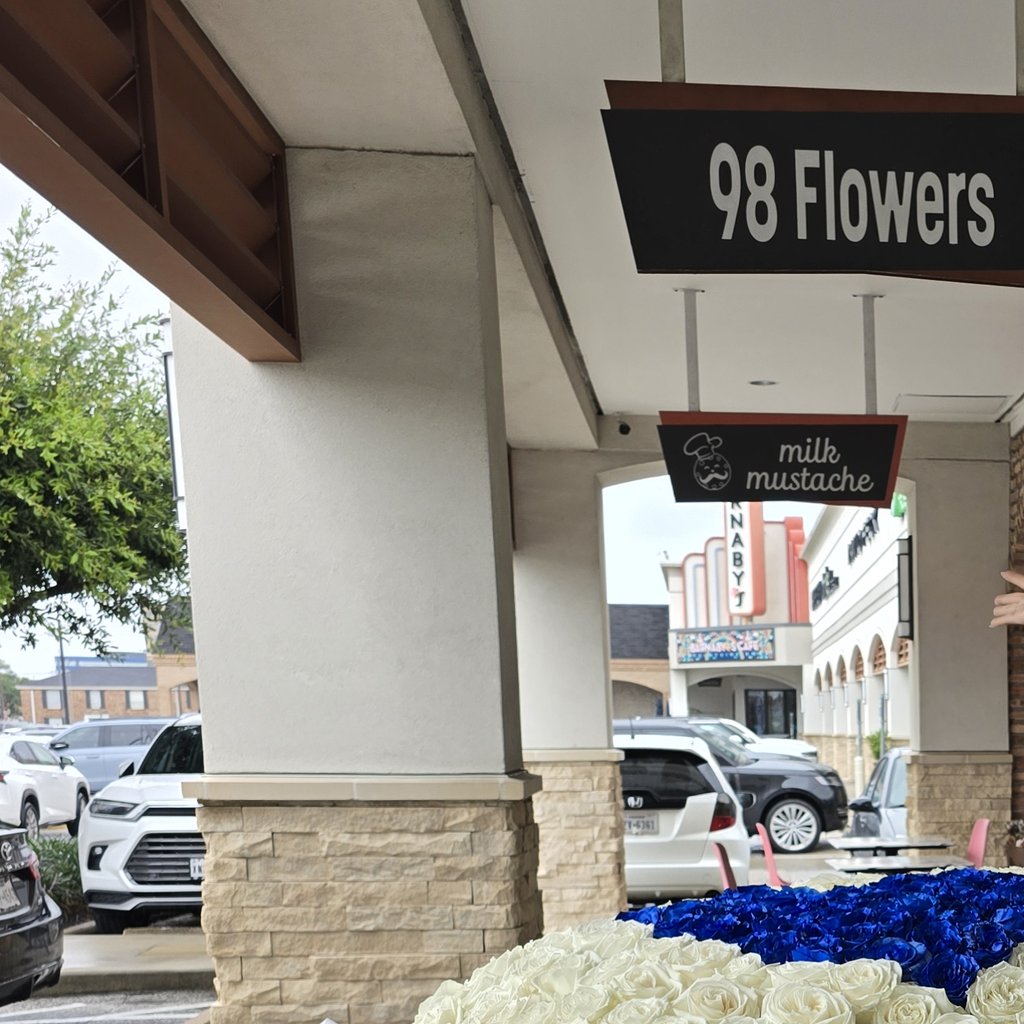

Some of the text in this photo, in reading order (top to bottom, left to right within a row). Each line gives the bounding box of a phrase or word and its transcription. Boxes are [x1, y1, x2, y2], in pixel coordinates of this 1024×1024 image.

[710, 142, 995, 247] 98 Flowers
[779, 437, 841, 463] milk
[746, 465, 874, 492] mustache
